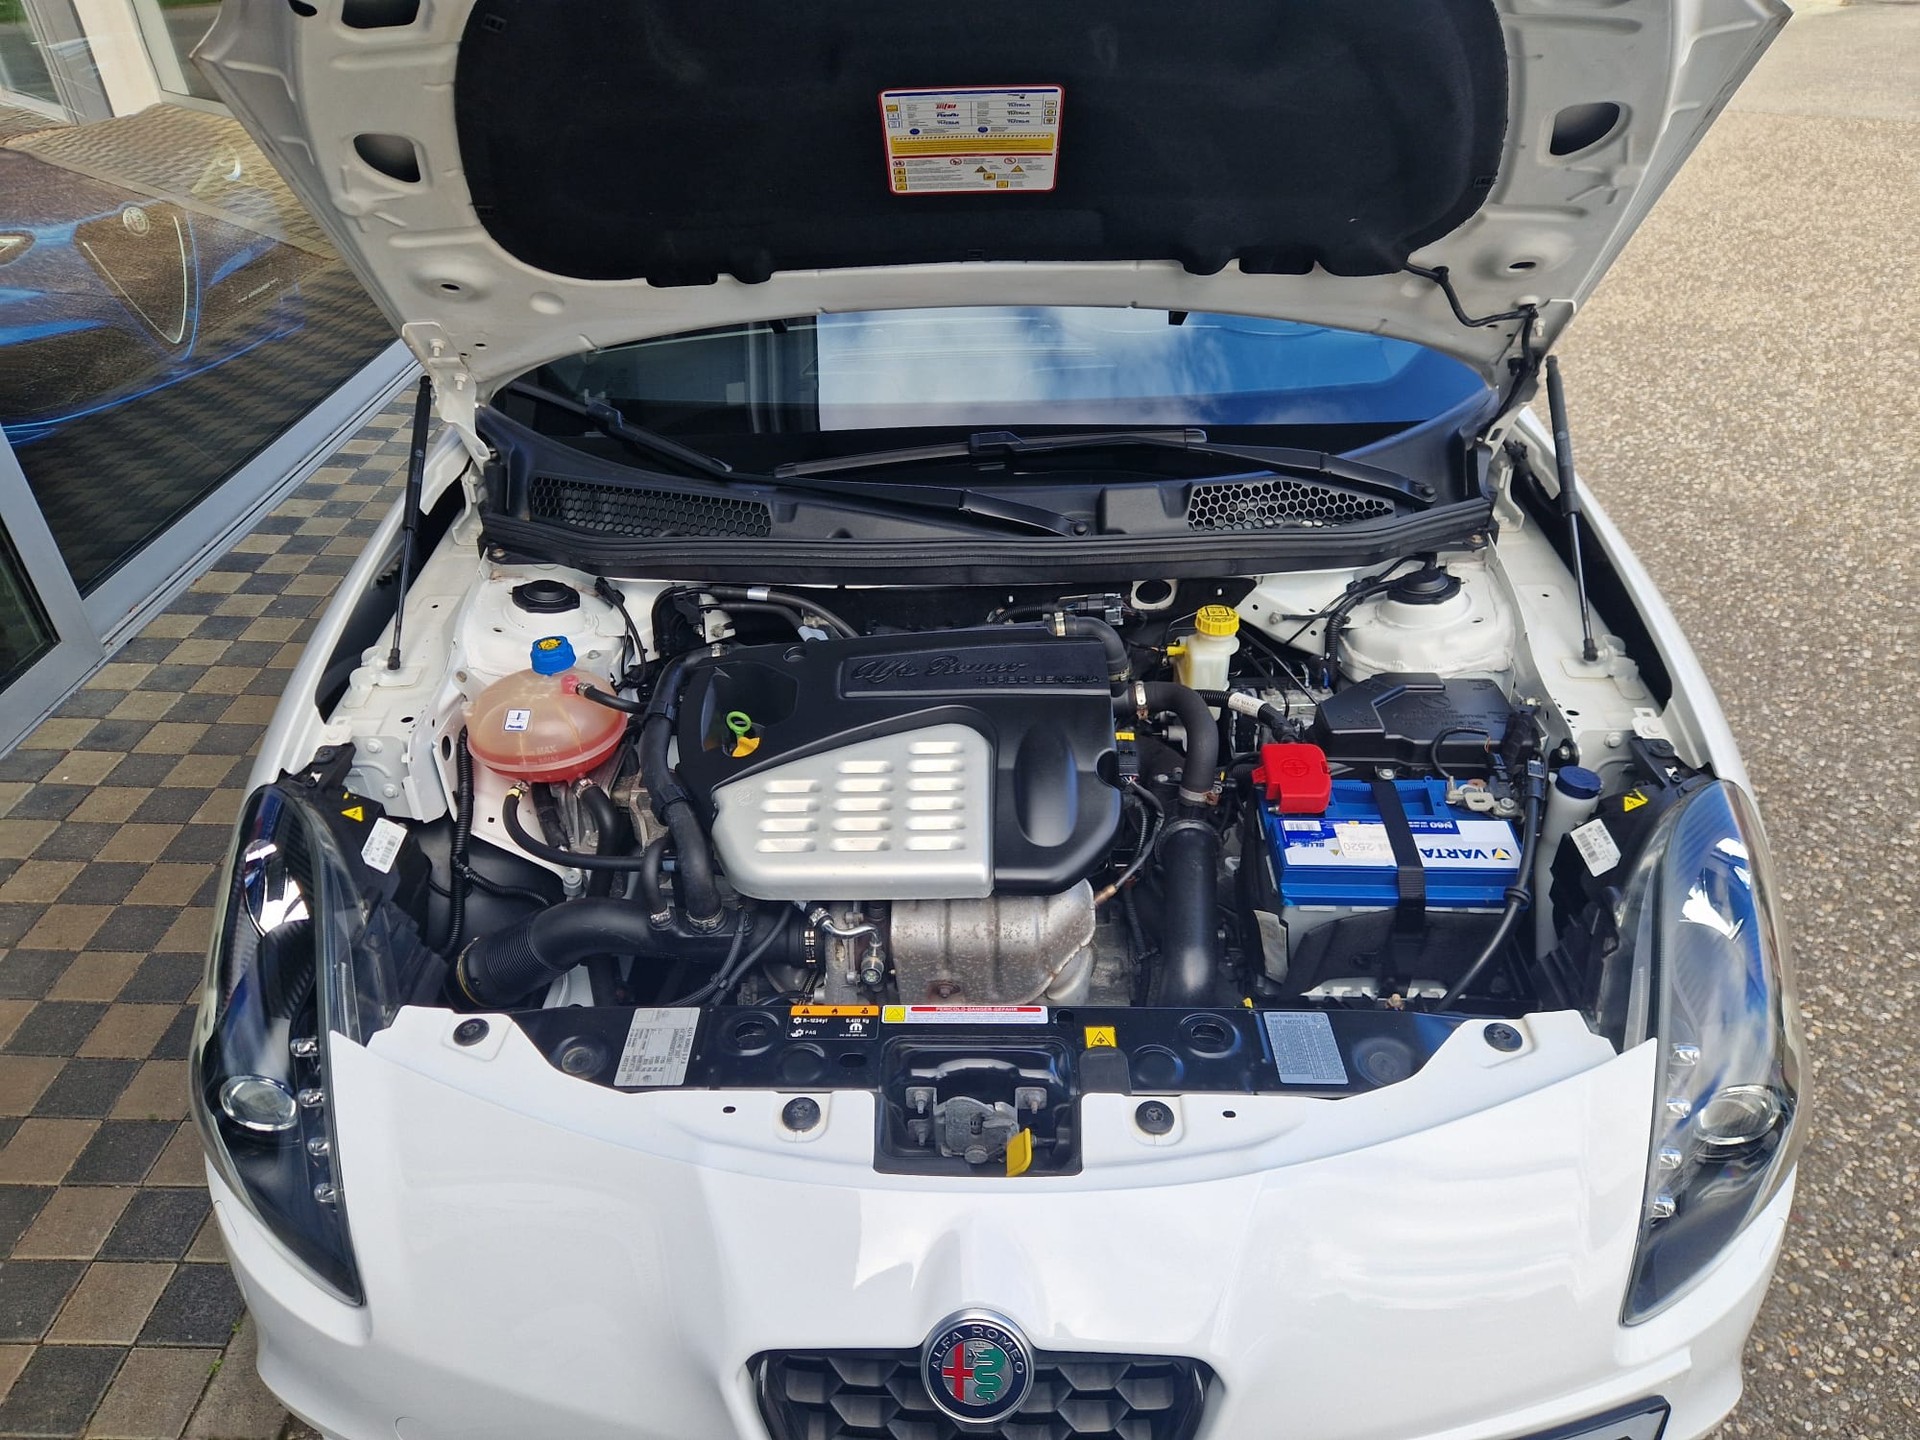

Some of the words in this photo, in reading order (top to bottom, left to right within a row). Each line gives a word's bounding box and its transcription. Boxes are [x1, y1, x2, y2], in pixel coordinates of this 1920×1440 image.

[852, 658, 919, 684] Alfa
[926, 655, 1029, 677] Romeo
[1419, 848, 1489, 860] VARTA
[930, 1331, 964, 1372] ALFA
[971, 1325, 1025, 1375] ROMEO
